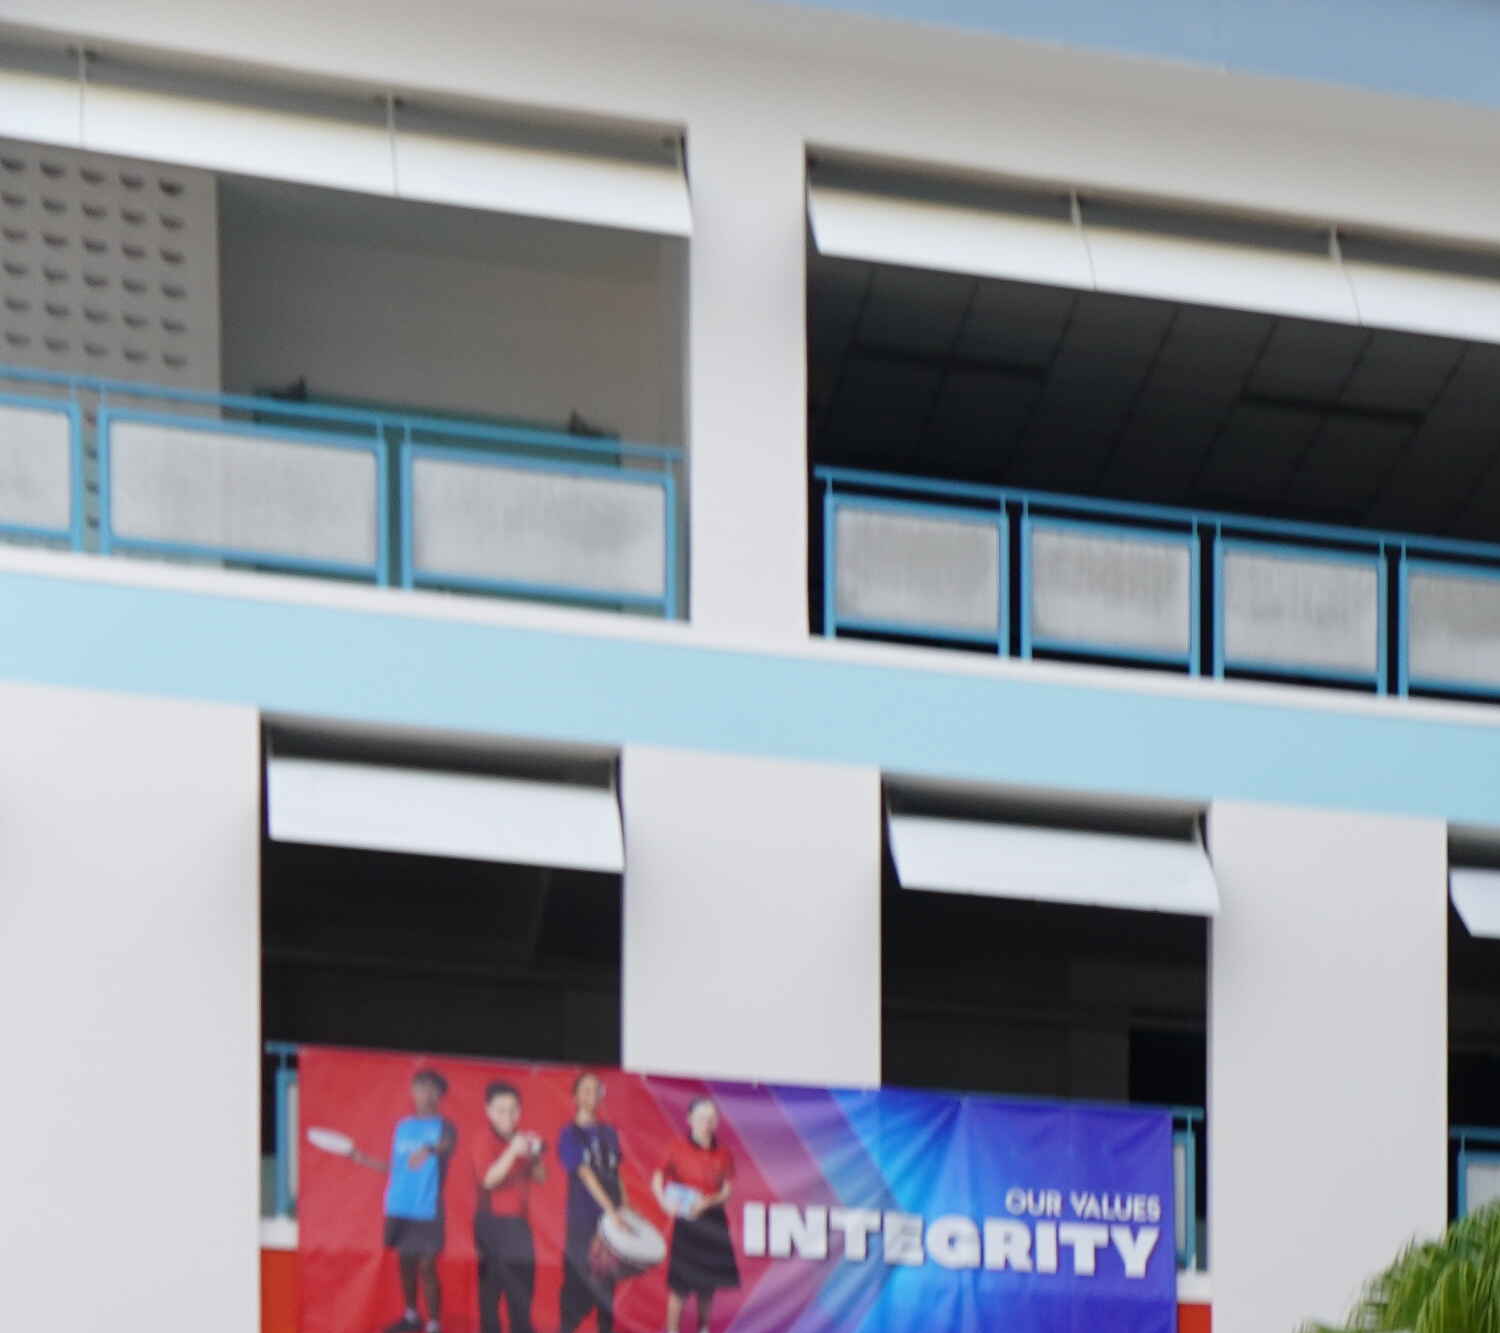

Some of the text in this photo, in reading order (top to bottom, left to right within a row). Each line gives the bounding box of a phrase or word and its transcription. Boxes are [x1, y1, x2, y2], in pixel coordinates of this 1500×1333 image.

[1004, 1188, 1162, 1223] OUR VALUES
[742, 1201, 1162, 1280] INTEGRITY
